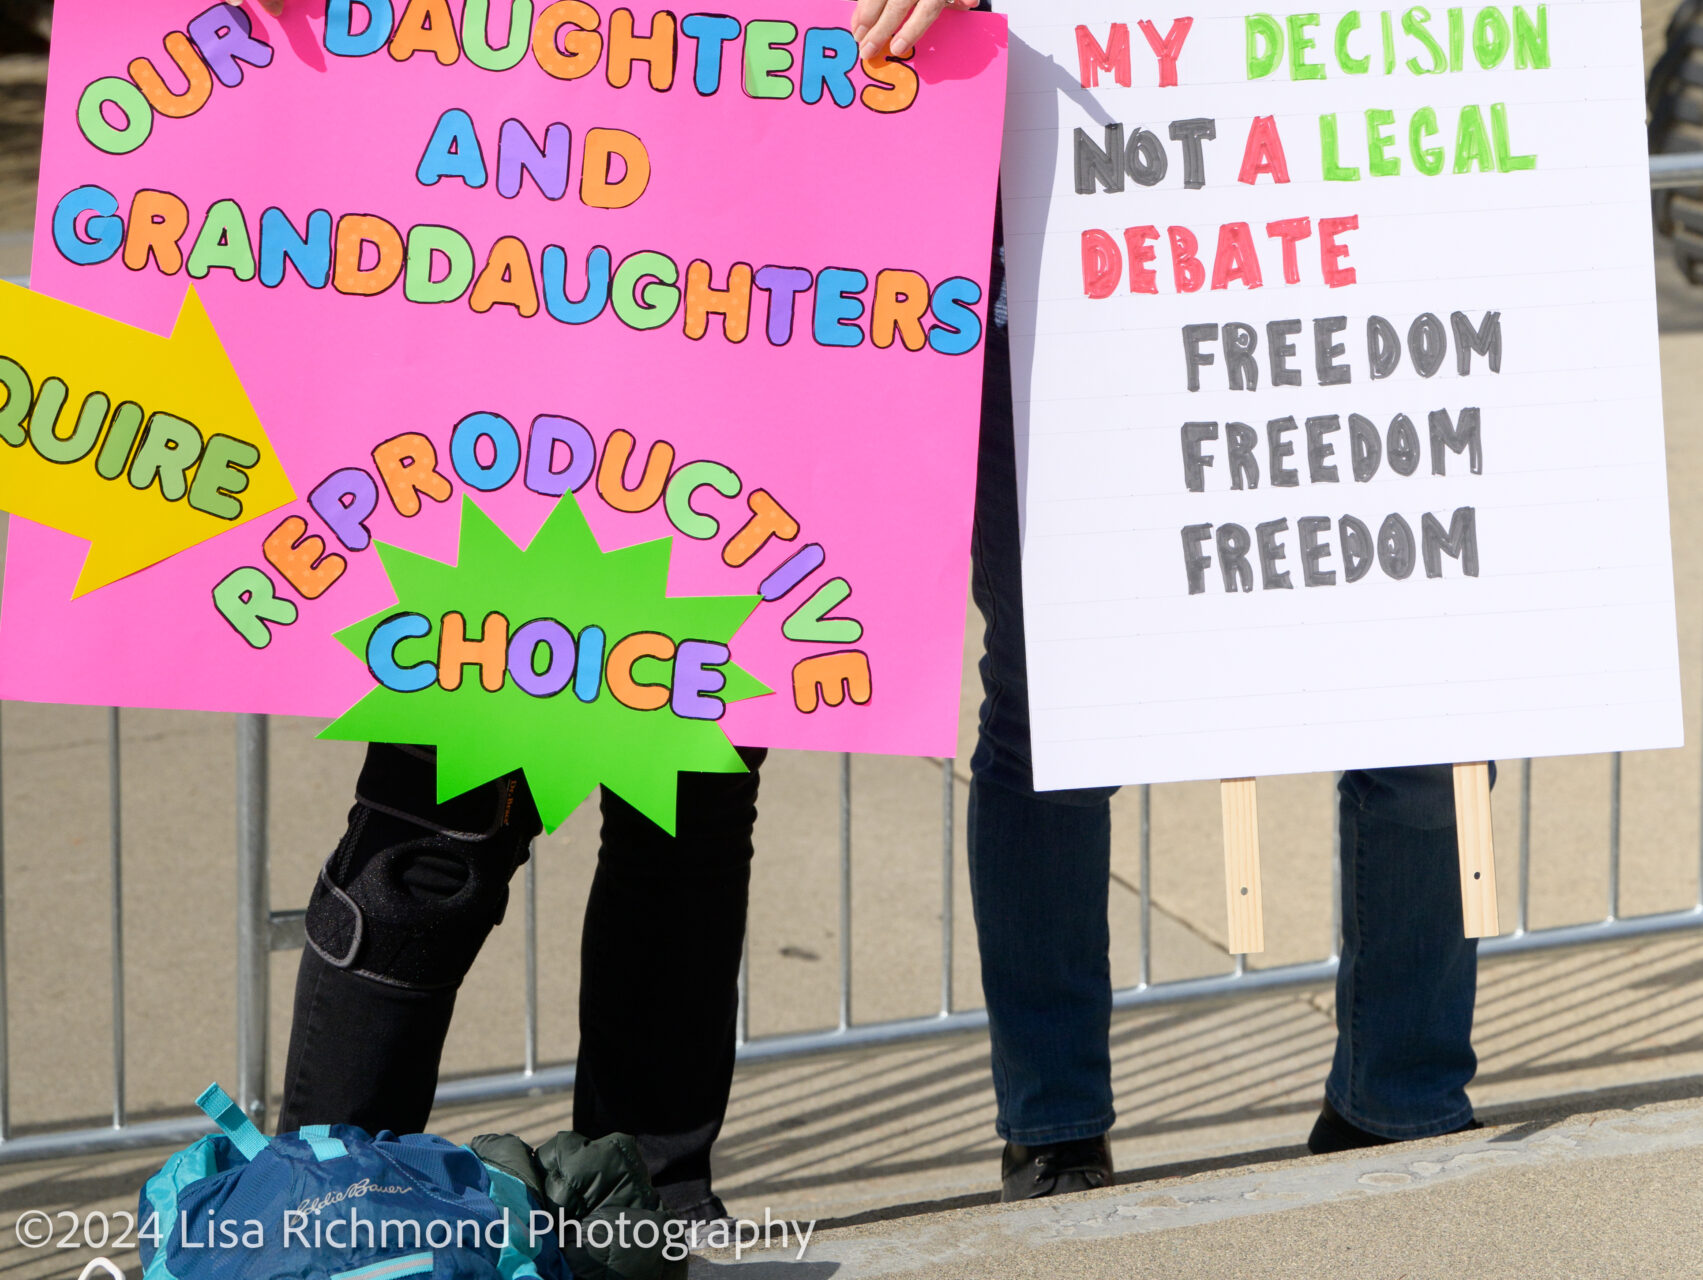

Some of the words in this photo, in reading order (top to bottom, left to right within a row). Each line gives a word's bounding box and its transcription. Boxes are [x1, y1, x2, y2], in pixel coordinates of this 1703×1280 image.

[76, 2, 273, 155] OUR
[1075, 16, 1194, 89] MY
[1245, 4, 1551, 81] DECISION
[416, 108, 651, 209] AND
[1073, 118, 1216, 194] NOT
[1237, 115, 1291, 186] A
[1318, 102, 1538, 182] LEGAL
[52, 184, 982, 356] GRANDDAUGHTERS
[1081, 214, 1359, 300] DEBATE
[1181, 310, 1502, 392] FREEDOM
[1181, 406, 1483, 492] FREEDOM
[211, 411, 872, 714] REPRODUCTIVE
[1181, 506, 1479, 595] FREEDOM
[365, 610, 731, 721] CHOICE
[290, 1190, 346, 1228] Eddie
[346, 1177, 413, 1199] Bauer
